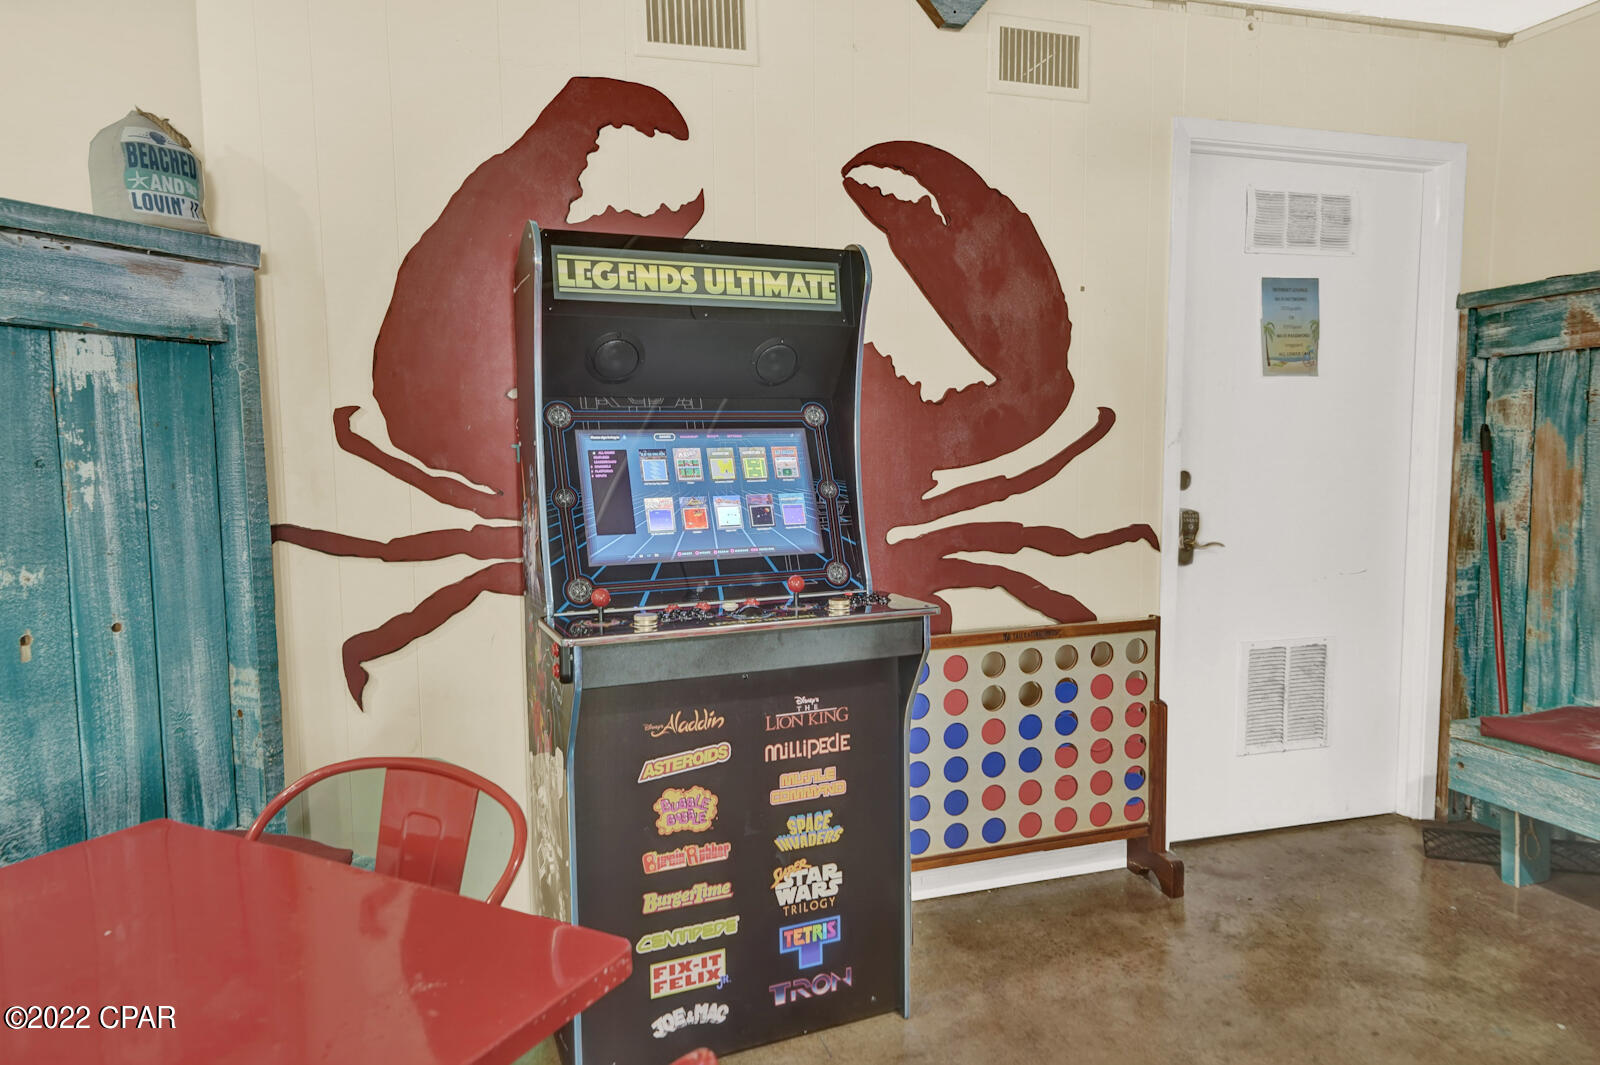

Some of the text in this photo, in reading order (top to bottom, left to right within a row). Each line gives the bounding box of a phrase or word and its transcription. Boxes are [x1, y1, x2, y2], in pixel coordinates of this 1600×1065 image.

[126, 141, 197, 180] BEACHED
[151, 173, 186, 194] AND
[557, 259, 837, 299] LEGENDS ULTIMATE
[765, 706, 849, 731] LION KING
[796, 703, 819, 712] THE
[651, 708, 725, 737] Aladdin
[640, 742, 730, 781] ASTEROIDS
[660, 794, 711, 814] BUBBLE
[770, 780, 847, 805] COMMAND
[667, 809, 708, 827] BOBBLE
[786, 809, 834, 834] SPACE
[774, 825, 844, 852] INVADERS
[775, 863, 843, 889] STAR
[775, 877, 843, 906] WARS
[783, 896, 836, 916] TRILOGY
[636, 915, 740, 954] CENTIPEDE
[783, 920, 837, 948] TETRIS
[653, 953, 722, 980] FIX-IT
[653, 967, 721, 994] FELIX
[769, 966, 852, 1006] TRON
[651, 1006, 688, 1038] JOE
[694, 1002, 730, 1025] MAC
